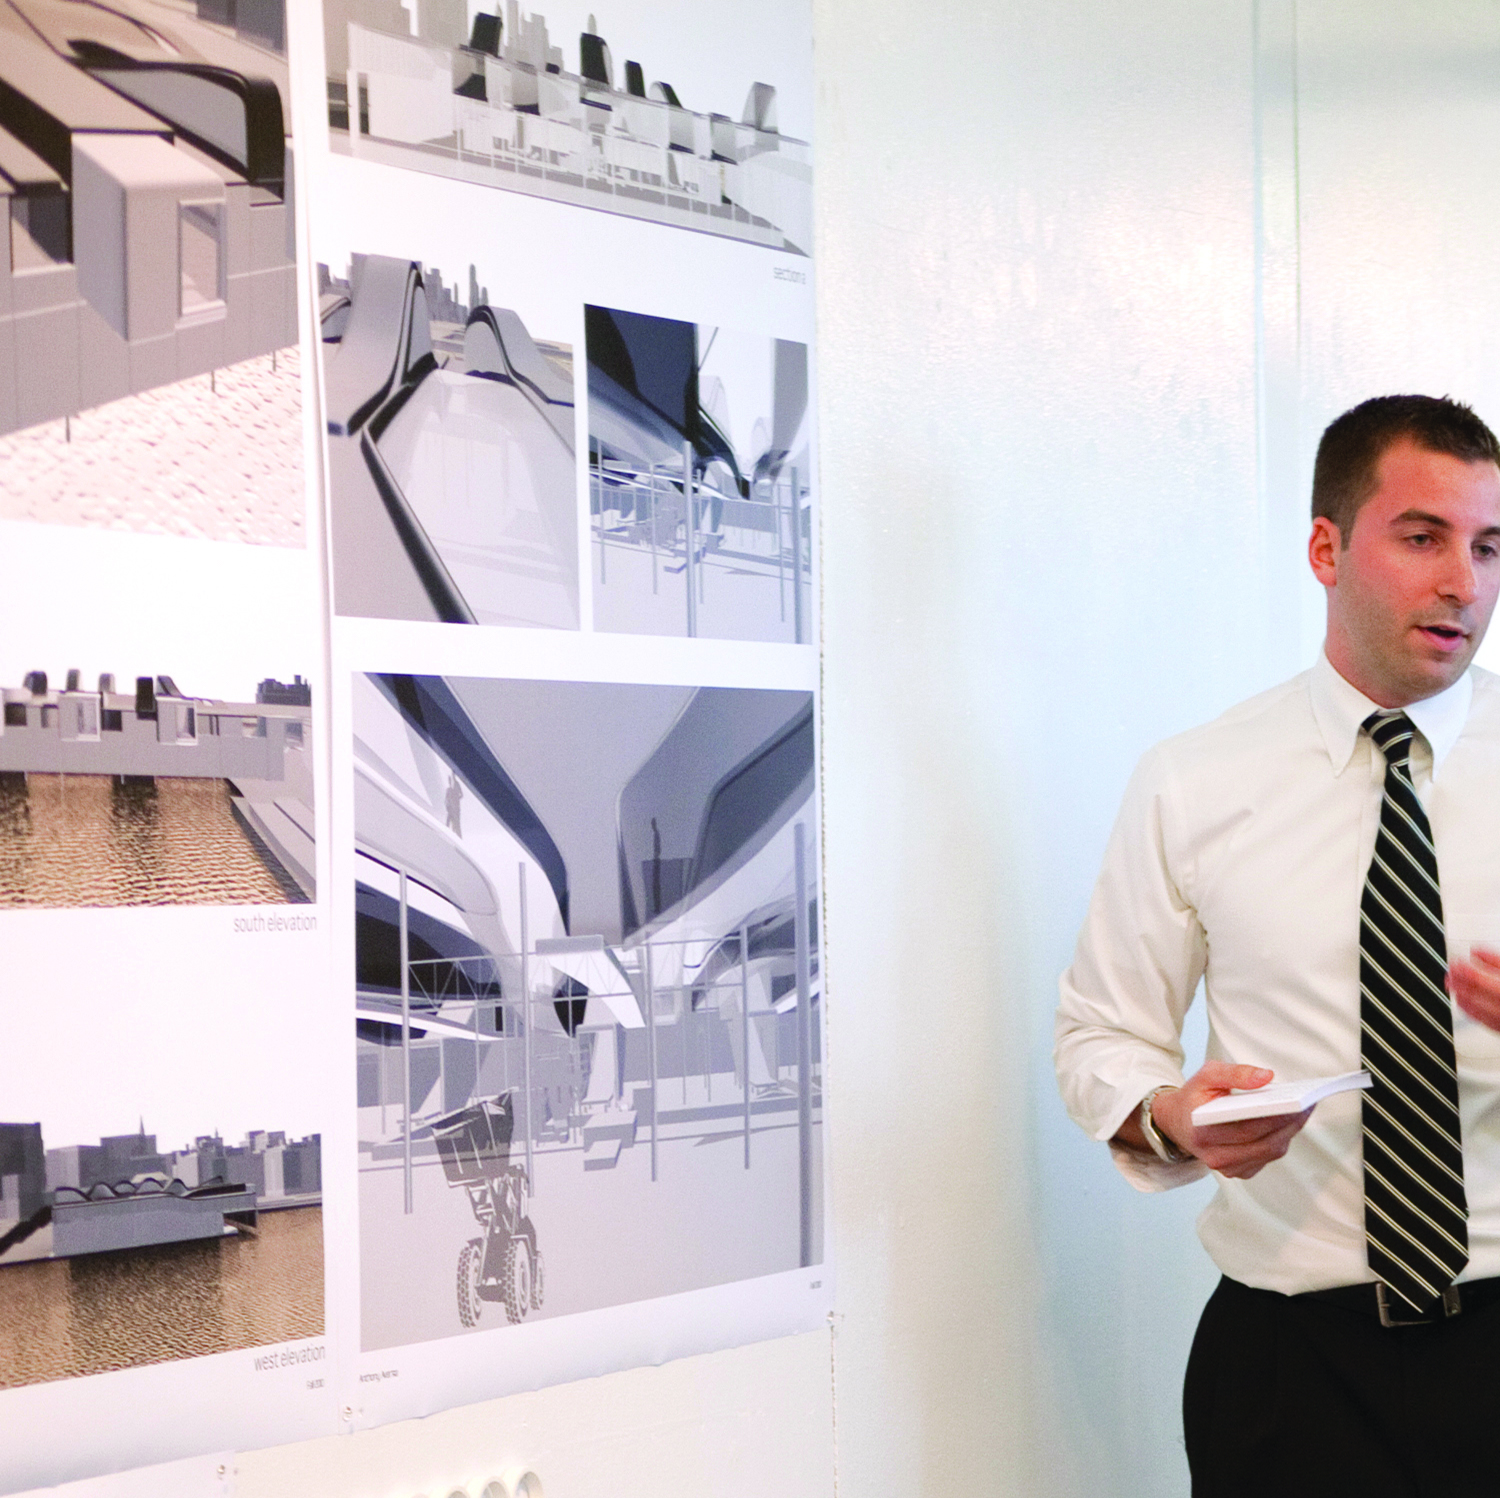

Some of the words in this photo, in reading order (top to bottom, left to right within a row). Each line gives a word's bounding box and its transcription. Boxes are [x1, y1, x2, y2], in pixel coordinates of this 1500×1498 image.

[233, 911, 265, 932] south
[267, 910, 317, 932] elevation
[253, 1352, 279, 1372] west
[280, 1343, 326, 1367] elevation
